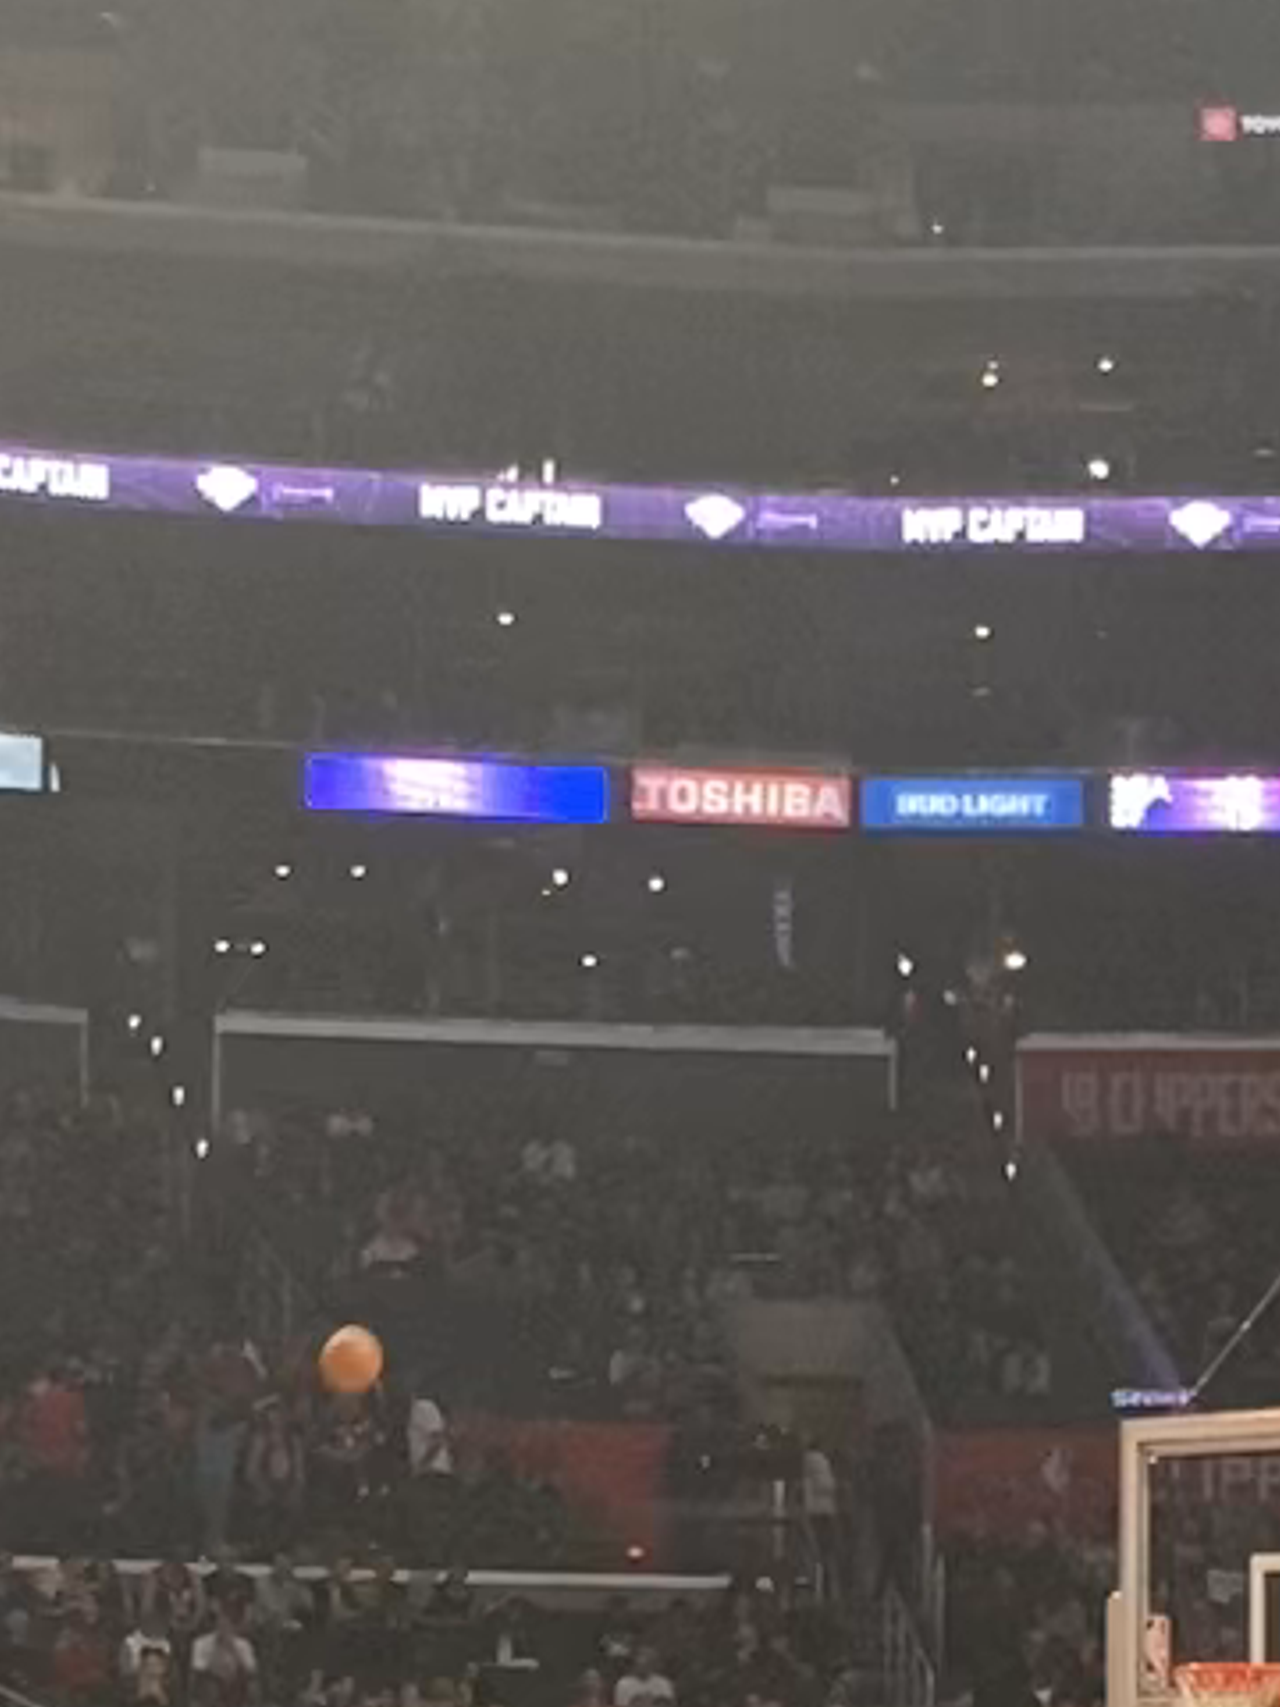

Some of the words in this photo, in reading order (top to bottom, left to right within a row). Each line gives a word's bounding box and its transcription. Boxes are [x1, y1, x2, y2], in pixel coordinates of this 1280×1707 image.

[420, 483, 480, 521] MVP
[485, 488, 601, 528] CAPTAIN
[902, 507, 963, 544] MVP
[967, 507, 1084, 544] CAPTAIN
[635, 777, 845, 821] TOSHIBA
[895, 793, 959, 819] BUD
[963, 793, 1048, 819] LIGHT
